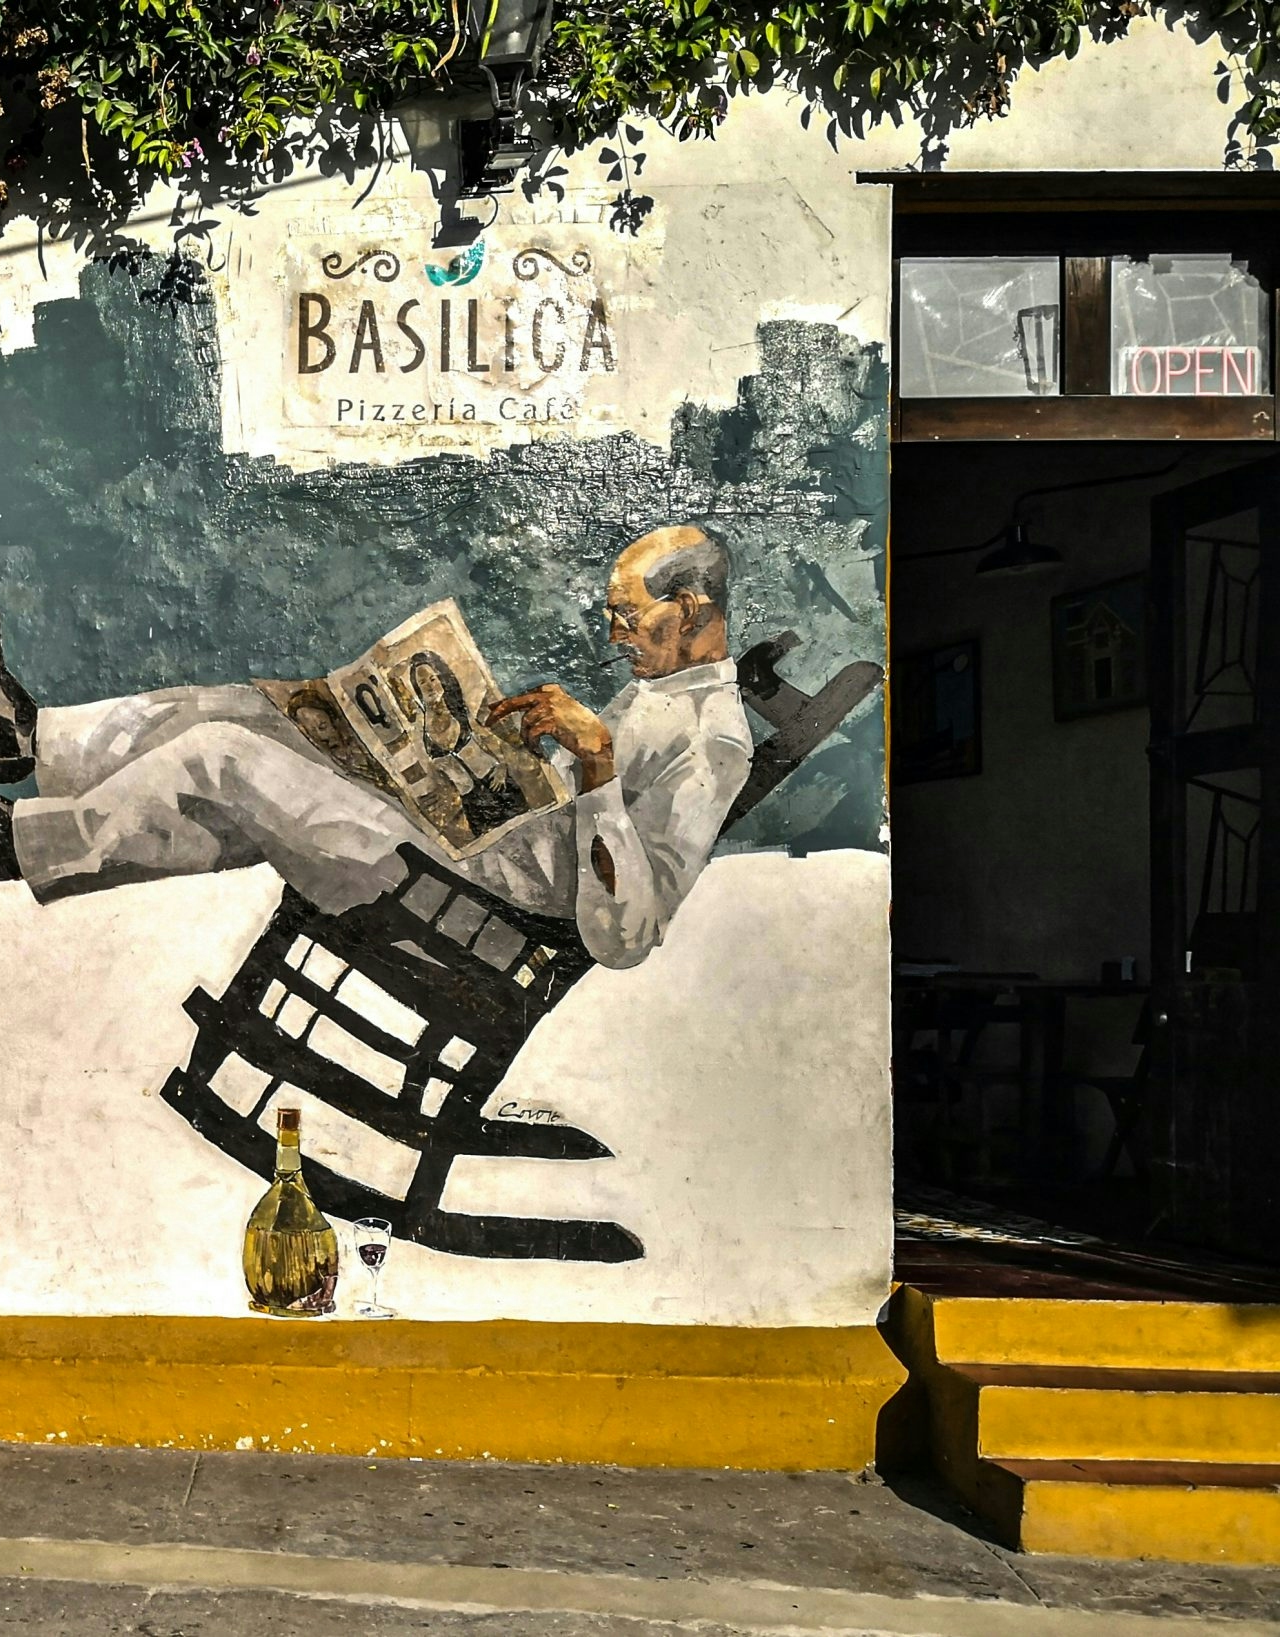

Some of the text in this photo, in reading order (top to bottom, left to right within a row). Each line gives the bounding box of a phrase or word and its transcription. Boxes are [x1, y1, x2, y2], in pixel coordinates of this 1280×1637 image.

[298, 292, 619, 375] BASILICA
[1131, 346, 1257, 395] OPEN
[337, 397, 574, 421] Pizzería Café
